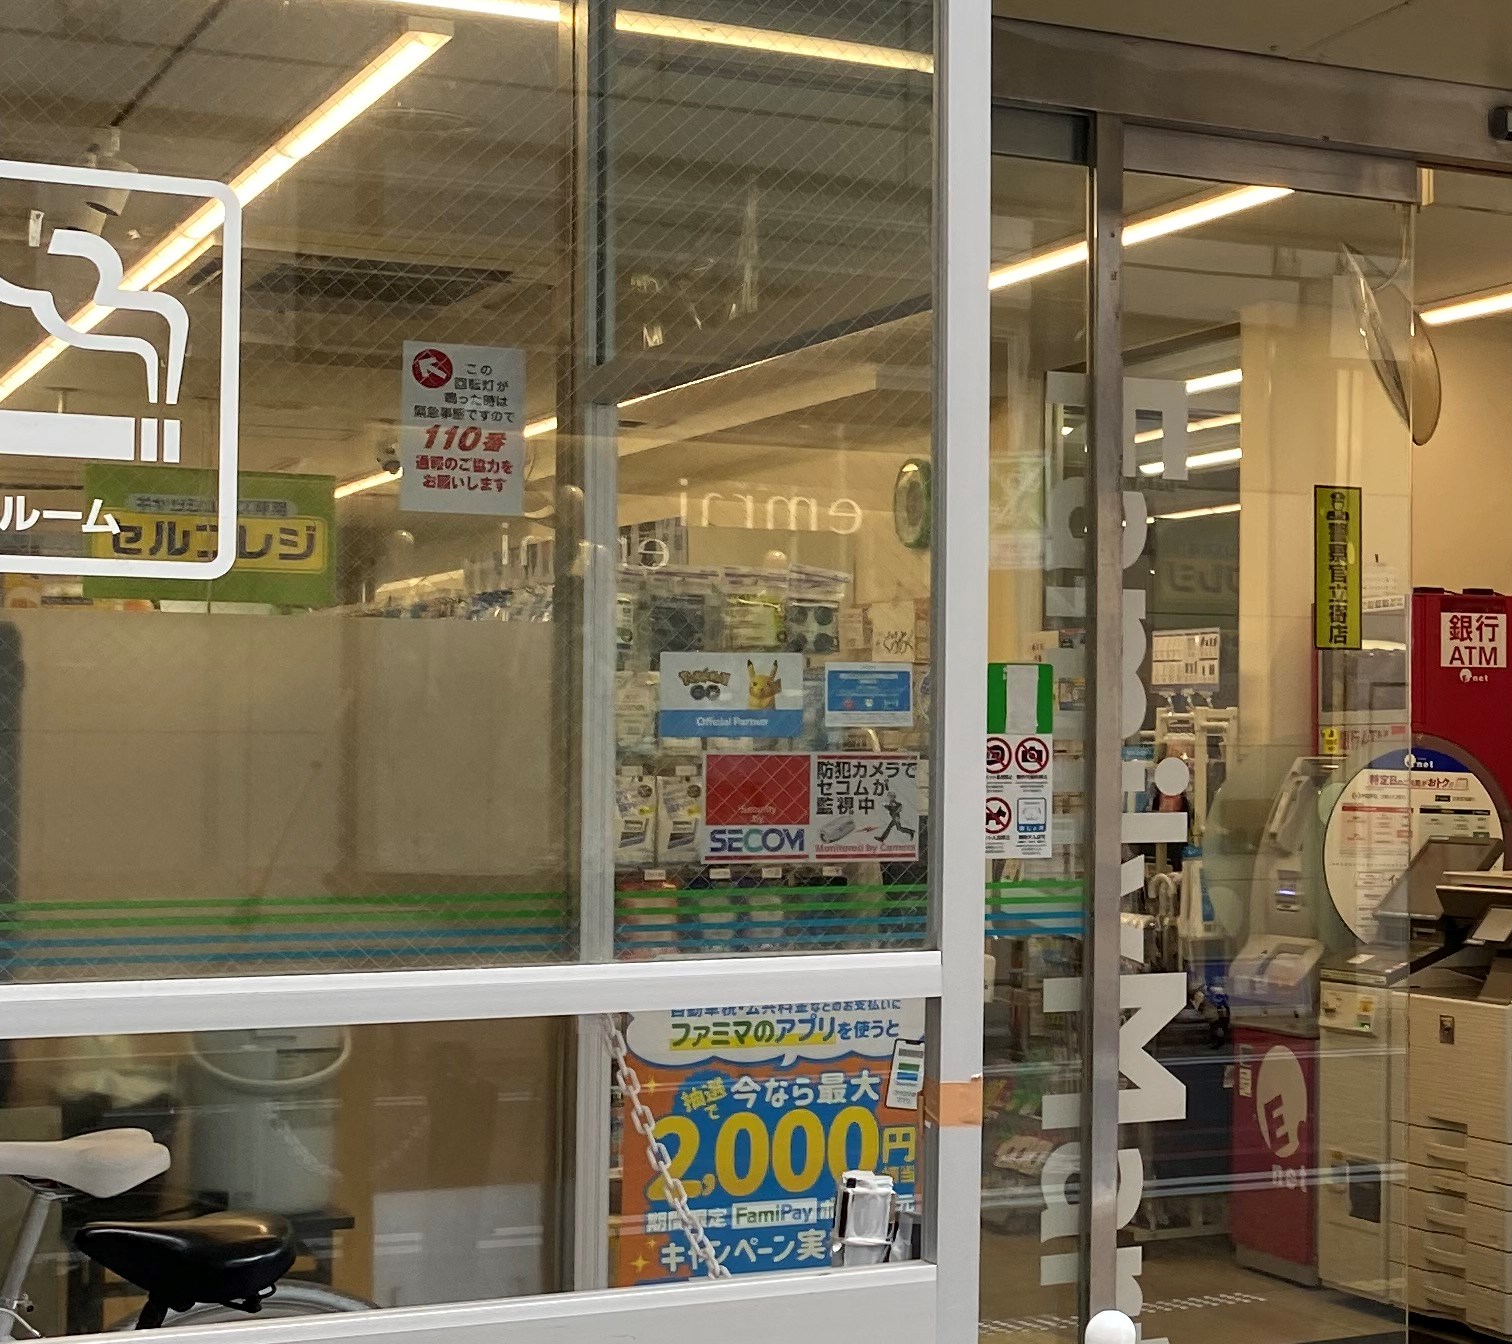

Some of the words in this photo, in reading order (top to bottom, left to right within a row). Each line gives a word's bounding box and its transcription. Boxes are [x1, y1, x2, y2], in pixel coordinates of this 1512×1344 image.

[466, 363, 493, 376] この
[424, 424, 507, 452] 110番
[0, 495, 121, 535] ルーム
[1449, 614, 1499, 643] 銀行
[1449, 646, 1499, 666] ATM
[816, 760, 918, 779] 防犯カメラで
[816, 778, 890, 796] セコムが
[816, 797, 875, 816] 監視中
[710, 828, 805, 853] SECOM
[671, 1016, 900, 1047] ファミマのアプリを使うと
[730, 1068, 881, 1109] 今なら最大
[735, 1203, 814, 1227] FamiPay
[661, 1229, 828, 1273] キャンペーン実
